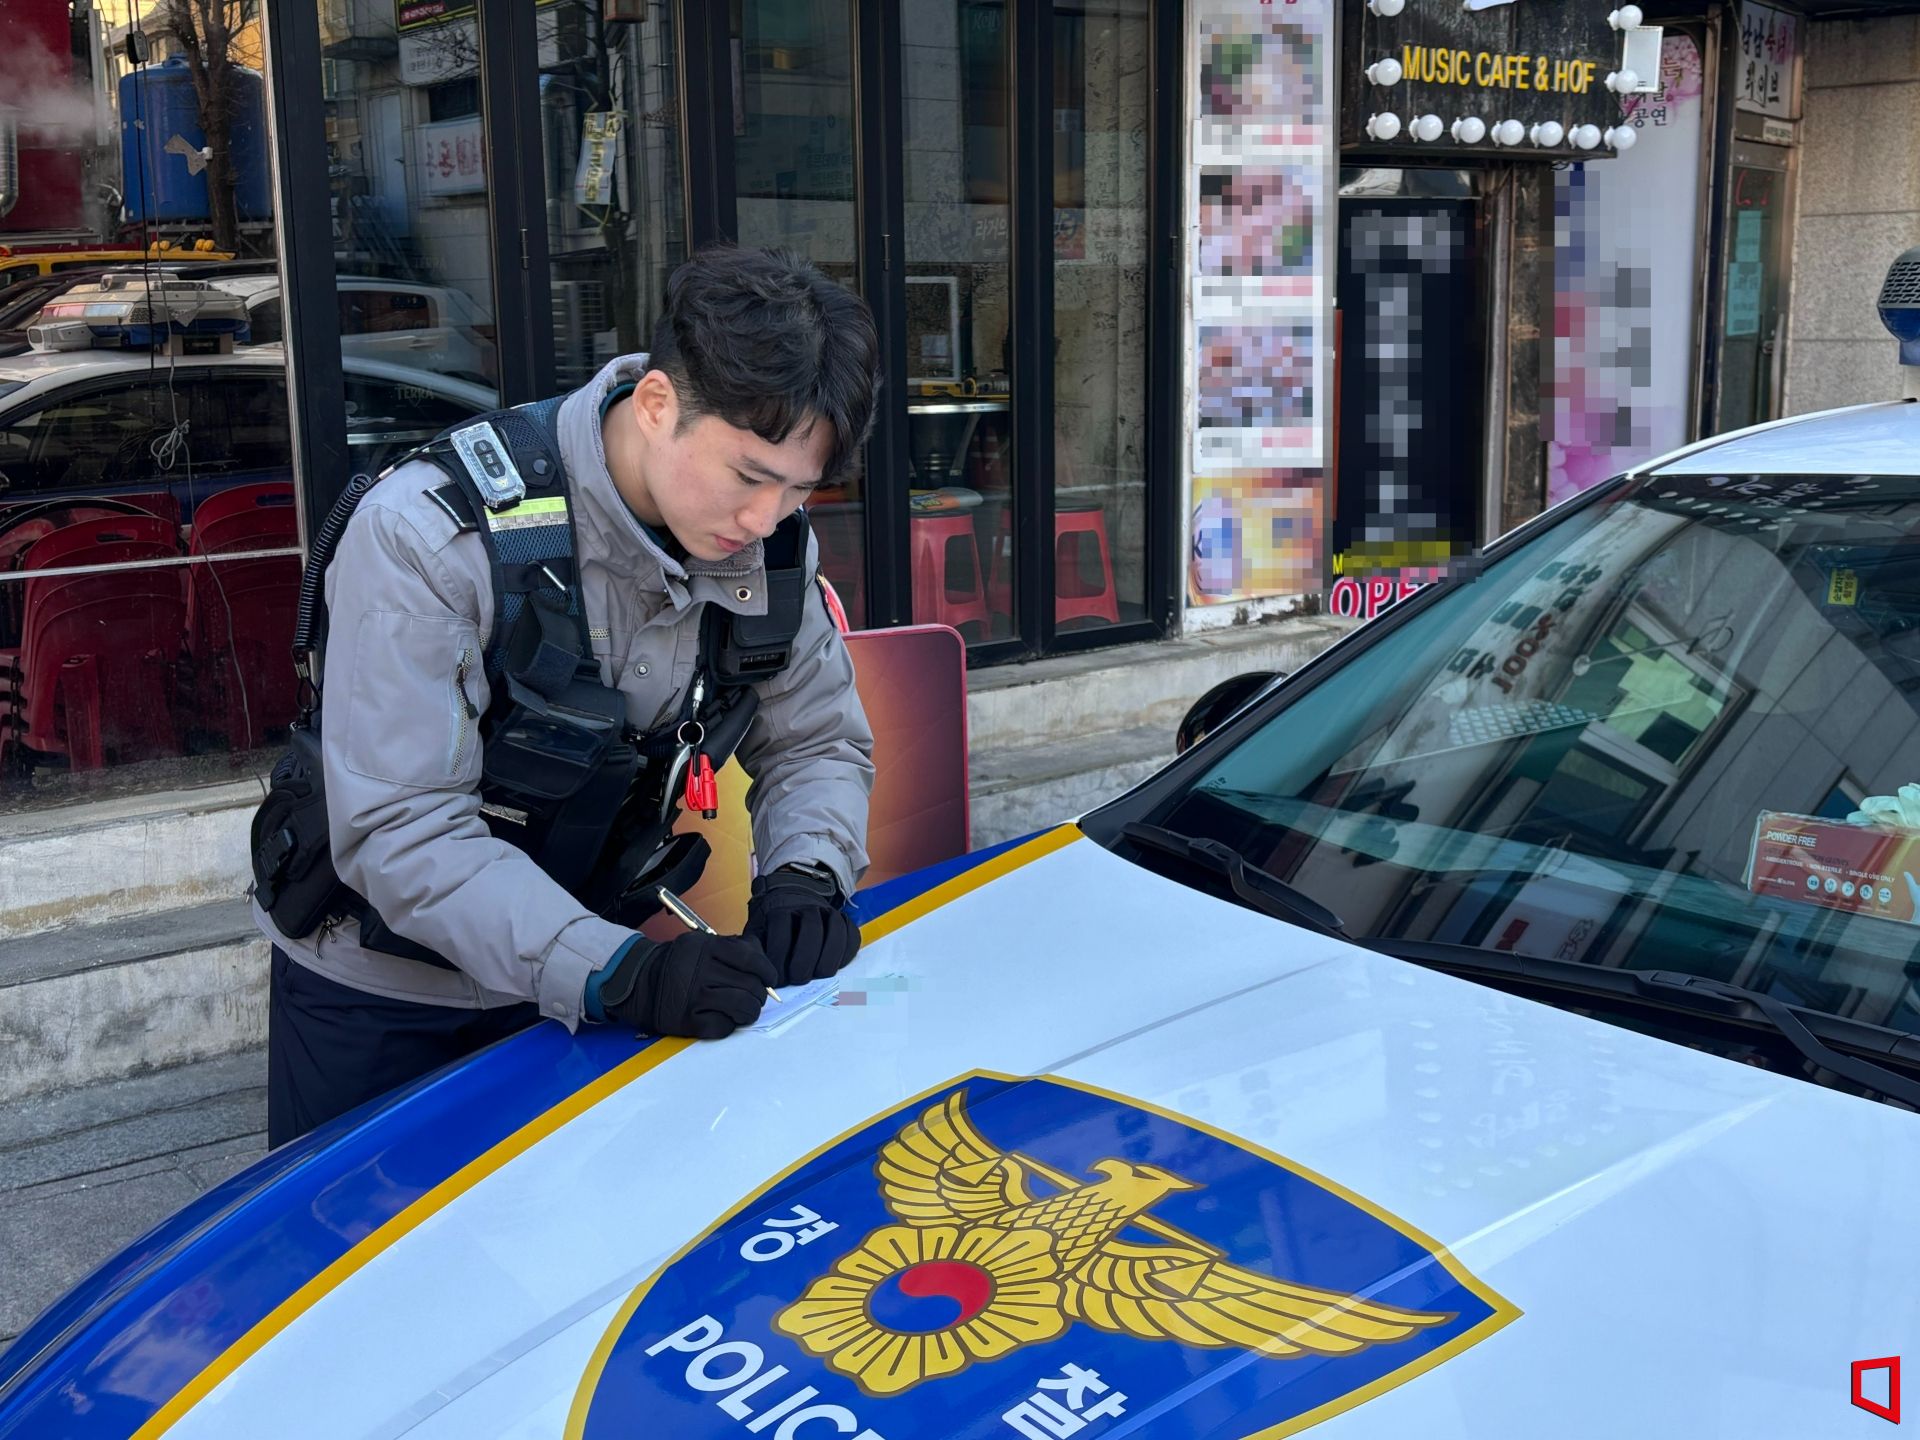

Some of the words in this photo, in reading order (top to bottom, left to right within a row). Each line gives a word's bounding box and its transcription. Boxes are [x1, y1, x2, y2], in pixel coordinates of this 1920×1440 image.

[1402, 45, 1471, 86] MUSIC
[1475, 51, 1530, 90] CAFE
[1534, 56, 1549, 91] &
[1554, 59, 1596, 94] HOF
[1634, 106, 1668, 128] 공연
[395, 386, 434, 400] TERRA
[1766, 830, 1798, 846] POWDER
[1798, 834, 1817, 848] FREE
[739, 1203, 840, 1262] 경
[644, 1313, 885, 1440] POLIC
[1001, 1362, 1129, 1440] 찰
